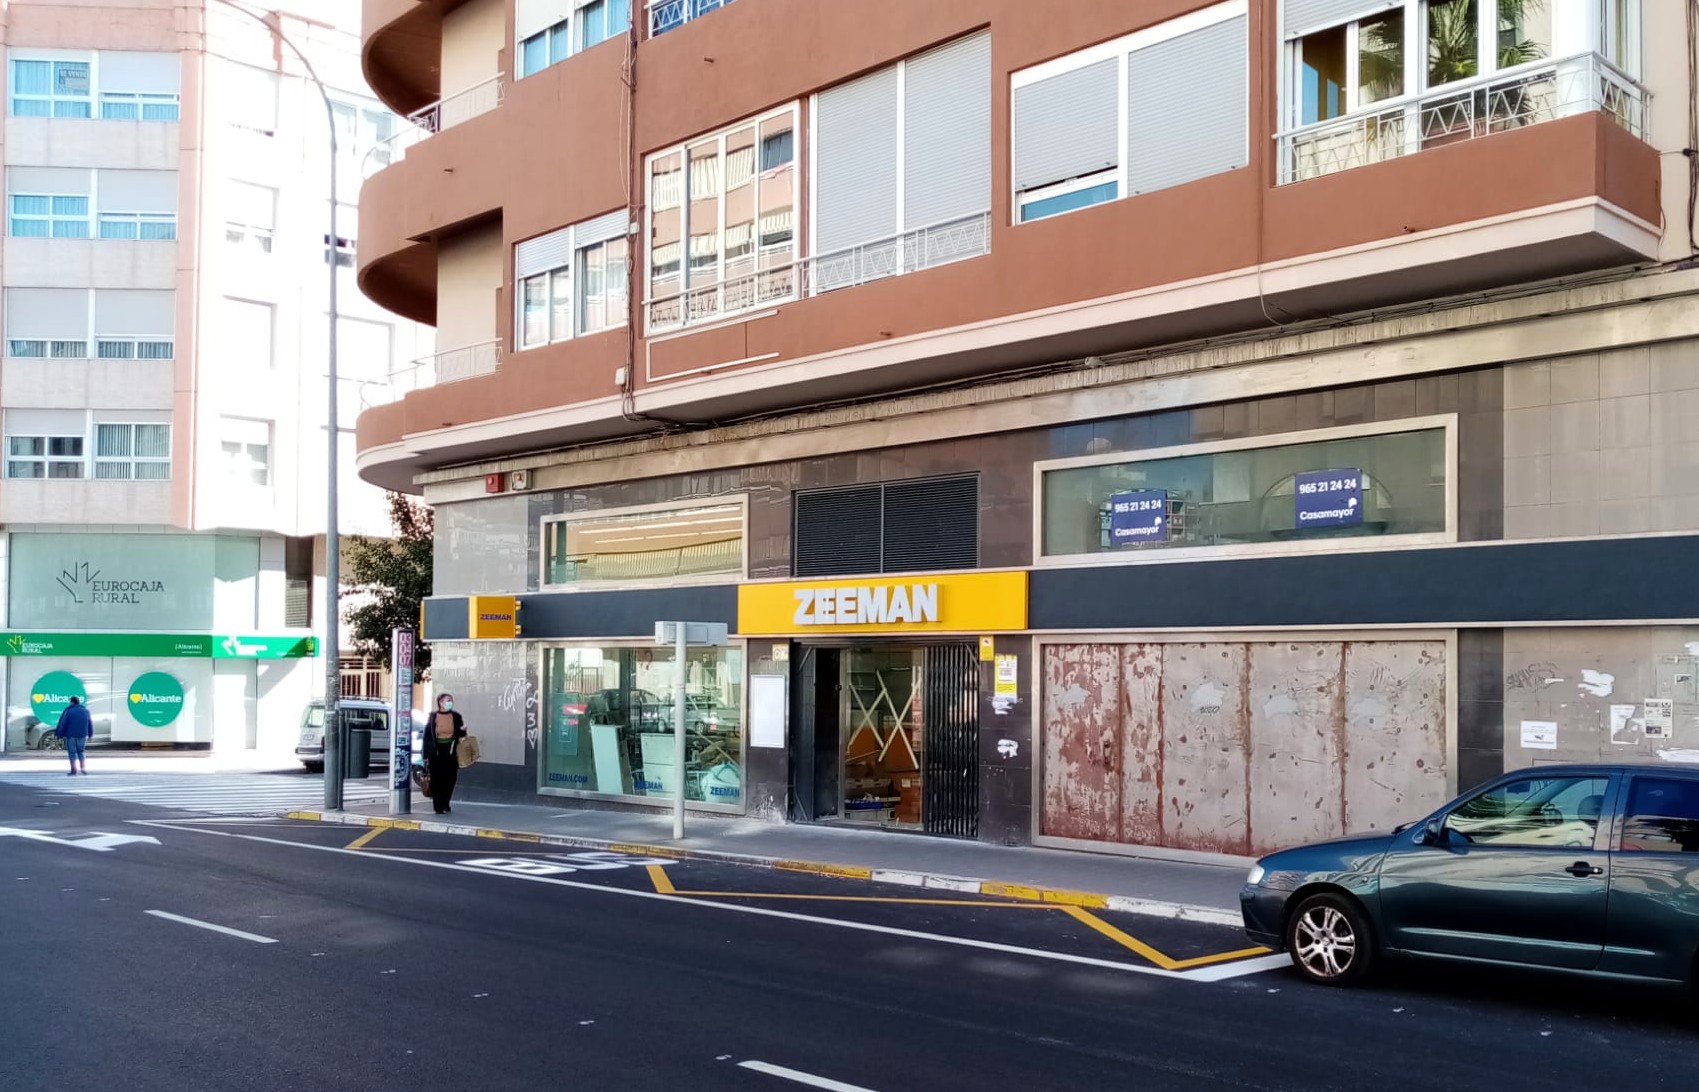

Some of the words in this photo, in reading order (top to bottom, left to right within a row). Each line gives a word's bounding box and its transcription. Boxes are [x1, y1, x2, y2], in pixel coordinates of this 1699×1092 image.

[1299, 483, 1316, 494] 965
[1317, 481, 1328, 492] 21
[1330, 480, 1342, 491] 24
[1344, 478, 1356, 489] 24
[1114, 503, 1129, 513] 965
[1129, 501, 1139, 511] 21
[1139, 500, 1150, 511] 24
[1151, 499, 1162, 509] 24
[1299, 508, 1354, 520] Casamayor
[1114, 526, 1160, 537] Casamayor
[92, 580, 164, 592] EUROCAJA
[92, 592, 140, 604] RURAL
[793, 583, 940, 625] ZEEMAN
[480, 613, 512, 621] ZEEMAN
[43, 694, 85, 703] Alicae
[141, 693, 182, 703] Alicante
[455, 852, 680, 875] BUS
